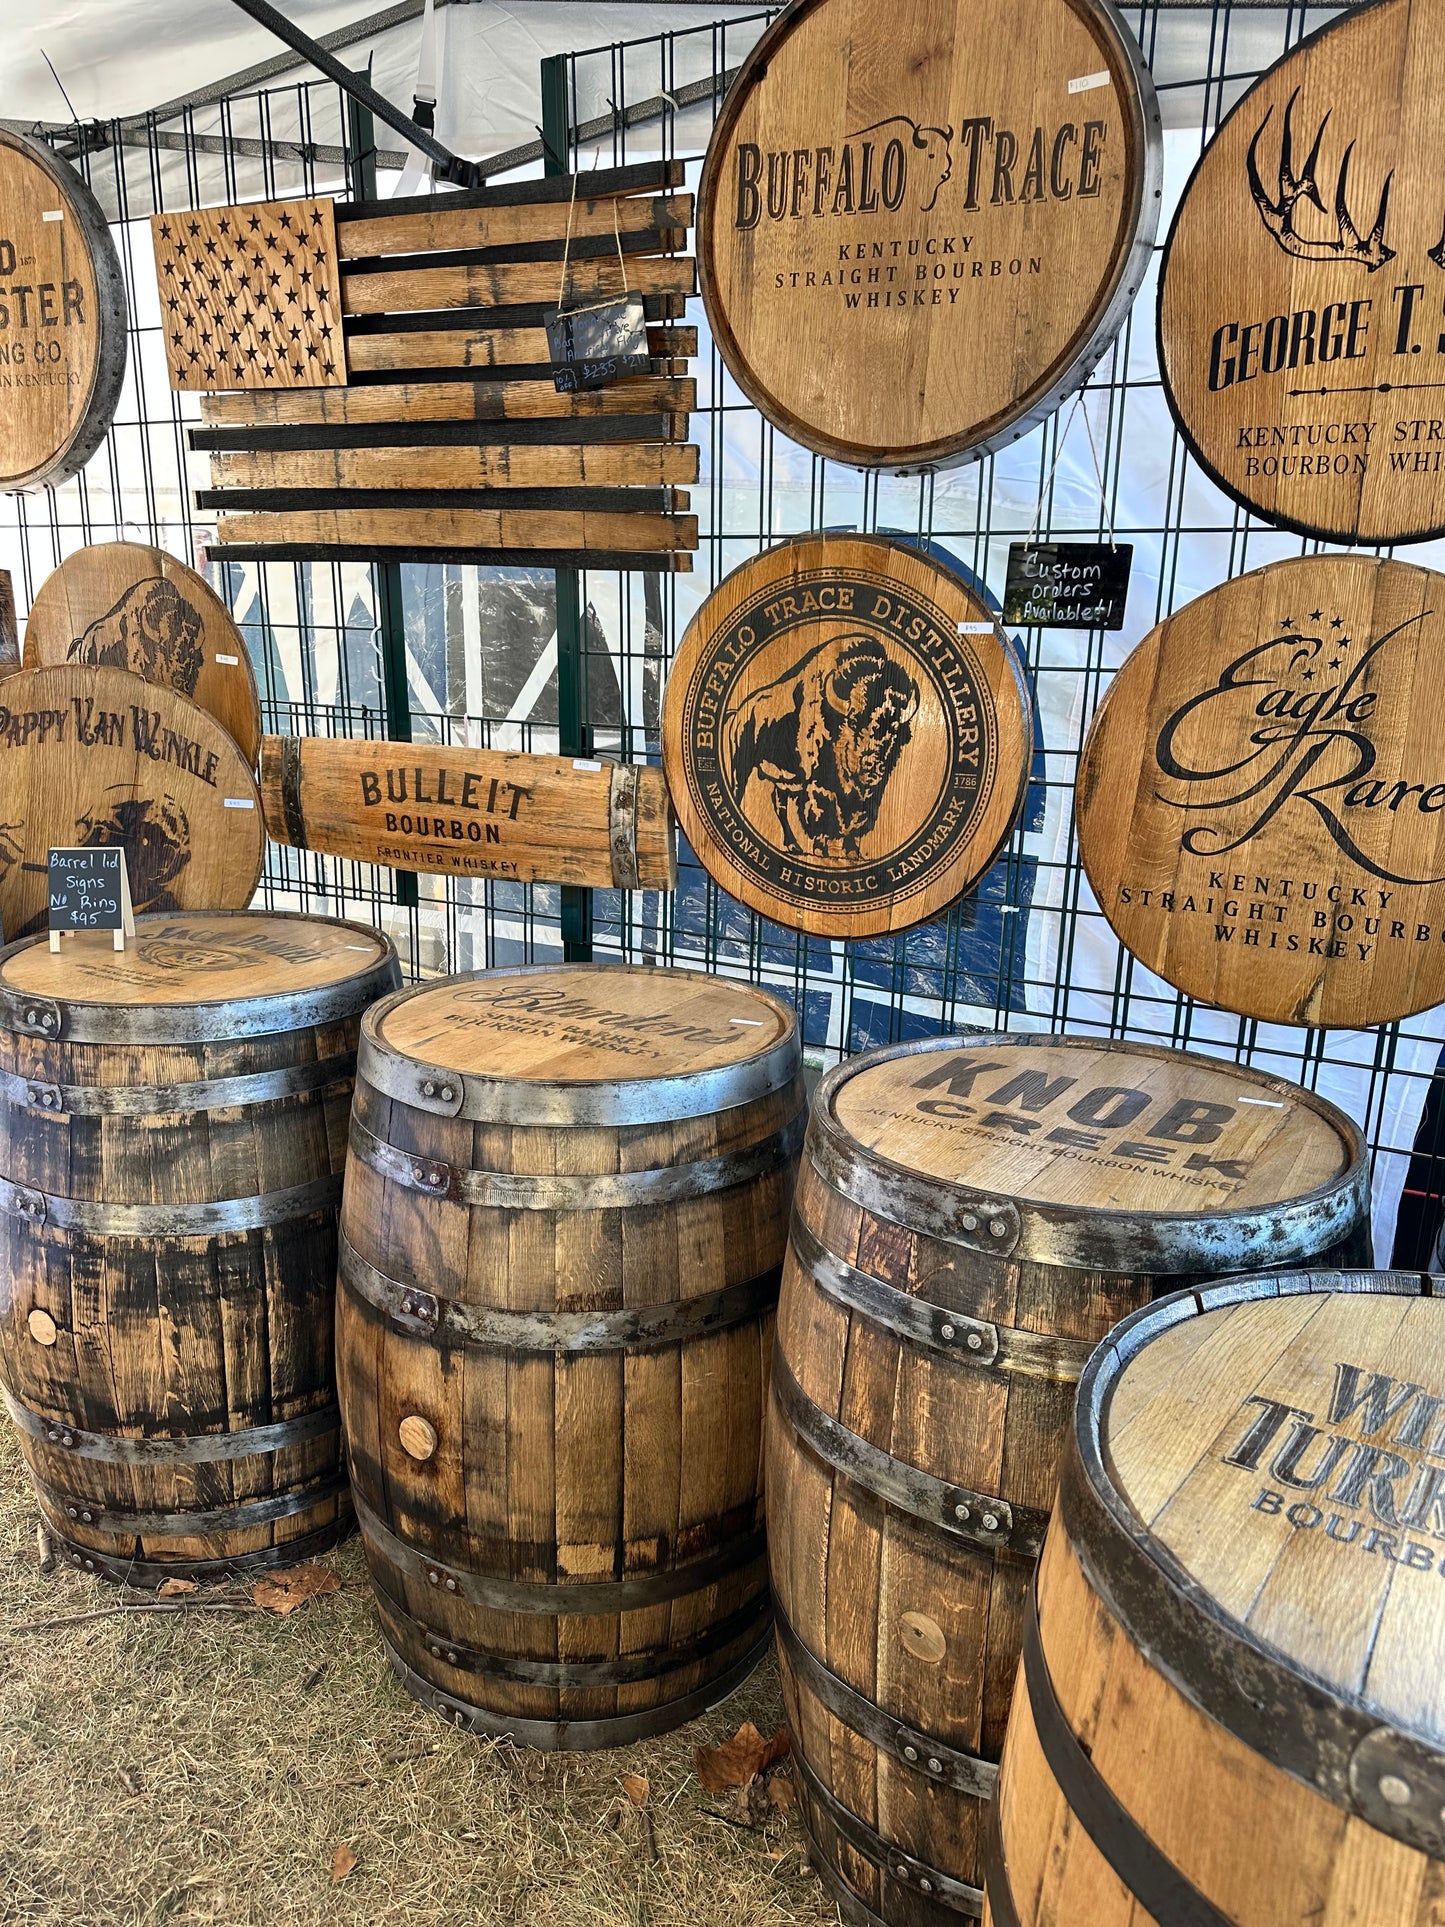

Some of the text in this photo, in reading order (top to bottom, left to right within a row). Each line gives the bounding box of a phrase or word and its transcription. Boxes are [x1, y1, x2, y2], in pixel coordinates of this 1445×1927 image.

[735, 116, 1107, 231] BUFFALO TRACE
[838, 235, 976, 261] KENTUCKY
[775, 257, 1043, 289] STRAIGHT BOURBON
[845, 288, 961, 309] WHISKEY
[34, 340, 68, 364] CO.
[1208, 299, 1372, 392] GEORGE
[1392, 285, 1425, 354] T.
[16, 372, 81, 387] KENTUCKY
[1236, 420, 1445, 449] KENTUCKY STR
[1245, 451, 1445, 477] BOURBON WHI
[1024, 551, 1101, 579] Custom
[697, 588, 981, 768] BUFFALO TRACE DISTILLERY
[1156, 611, 1433, 806] Eagle
[0, 697, 220, 788] PAPPY VAN WINKLE
[360, 768, 532, 820] BULLEIT
[954, 776, 977, 788] 1786
[1182, 729, 1445, 885] Rare
[385, 813, 501, 844] BOURBON
[706, 781, 966, 895] NATIONAL HISTORIC LANDMARK
[50, 851, 118, 868] Barrel lid
[377, 846, 518, 873] FRONTIER WHISKEY
[66, 875, 105, 896] Signs
[80, 895, 117, 912] Ring
[1208, 871, 1394, 910] KENTUCKY
[70, 911, 98, 925] $95
[1121, 886, 1445, 944] STRAIGHT BOURB
[1214, 924, 1374, 962] WHISKEY
[444, 1014, 669, 1059] BOURBON WHISKEY
[482, 1012, 653, 1048] SINGLE BARREL
[910, 1057, 1239, 1145] KNOB
[868, 1107, 1244, 1194] KENTUCKY STRAIGHT BOURBON WHISKEY
[916, 1099, 1252, 1181] CREEK
[1250, 1488, 1445, 1578] BOURB
